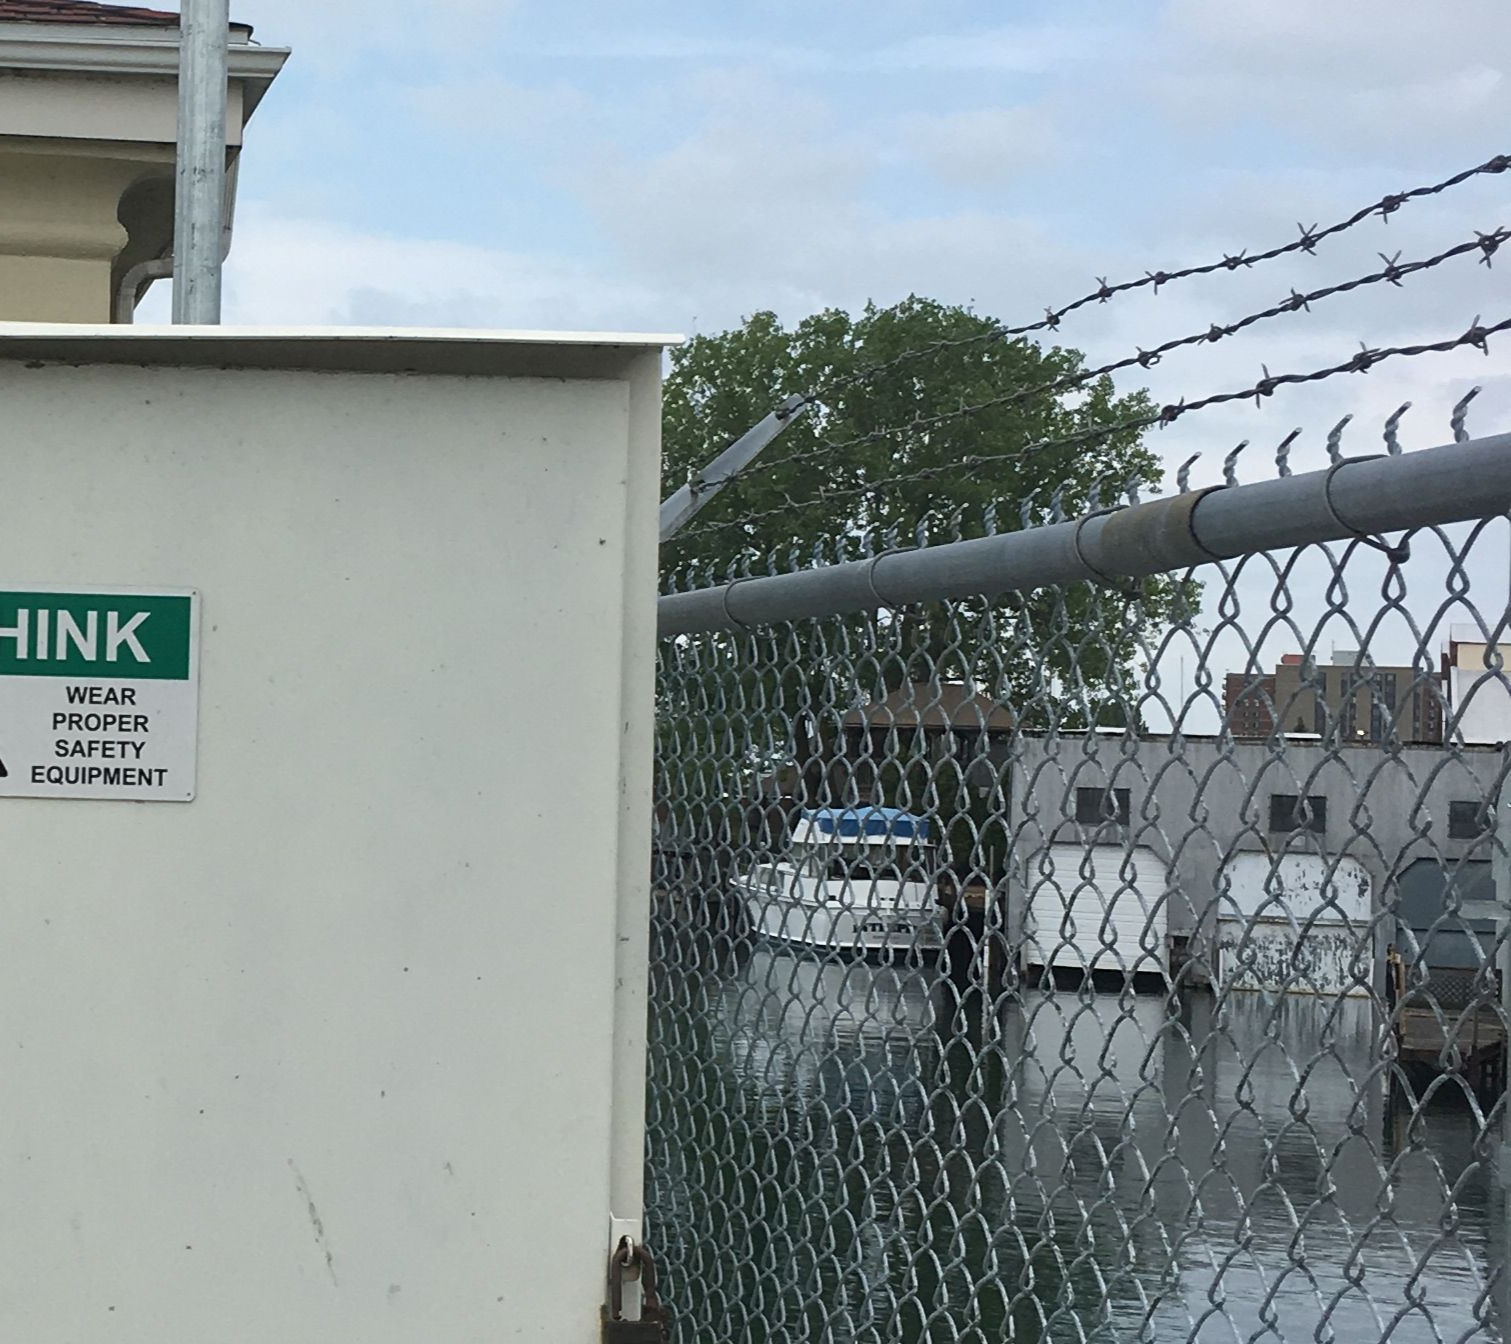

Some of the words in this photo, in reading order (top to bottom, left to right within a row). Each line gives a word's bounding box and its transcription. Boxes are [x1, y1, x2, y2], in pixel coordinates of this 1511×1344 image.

[66, 686, 137, 705] WEAR
[52, 713, 149, 733] PROPER
[54, 739, 146, 759] SAFETY
[31, 765, 168, 787] EQUIPMENT
